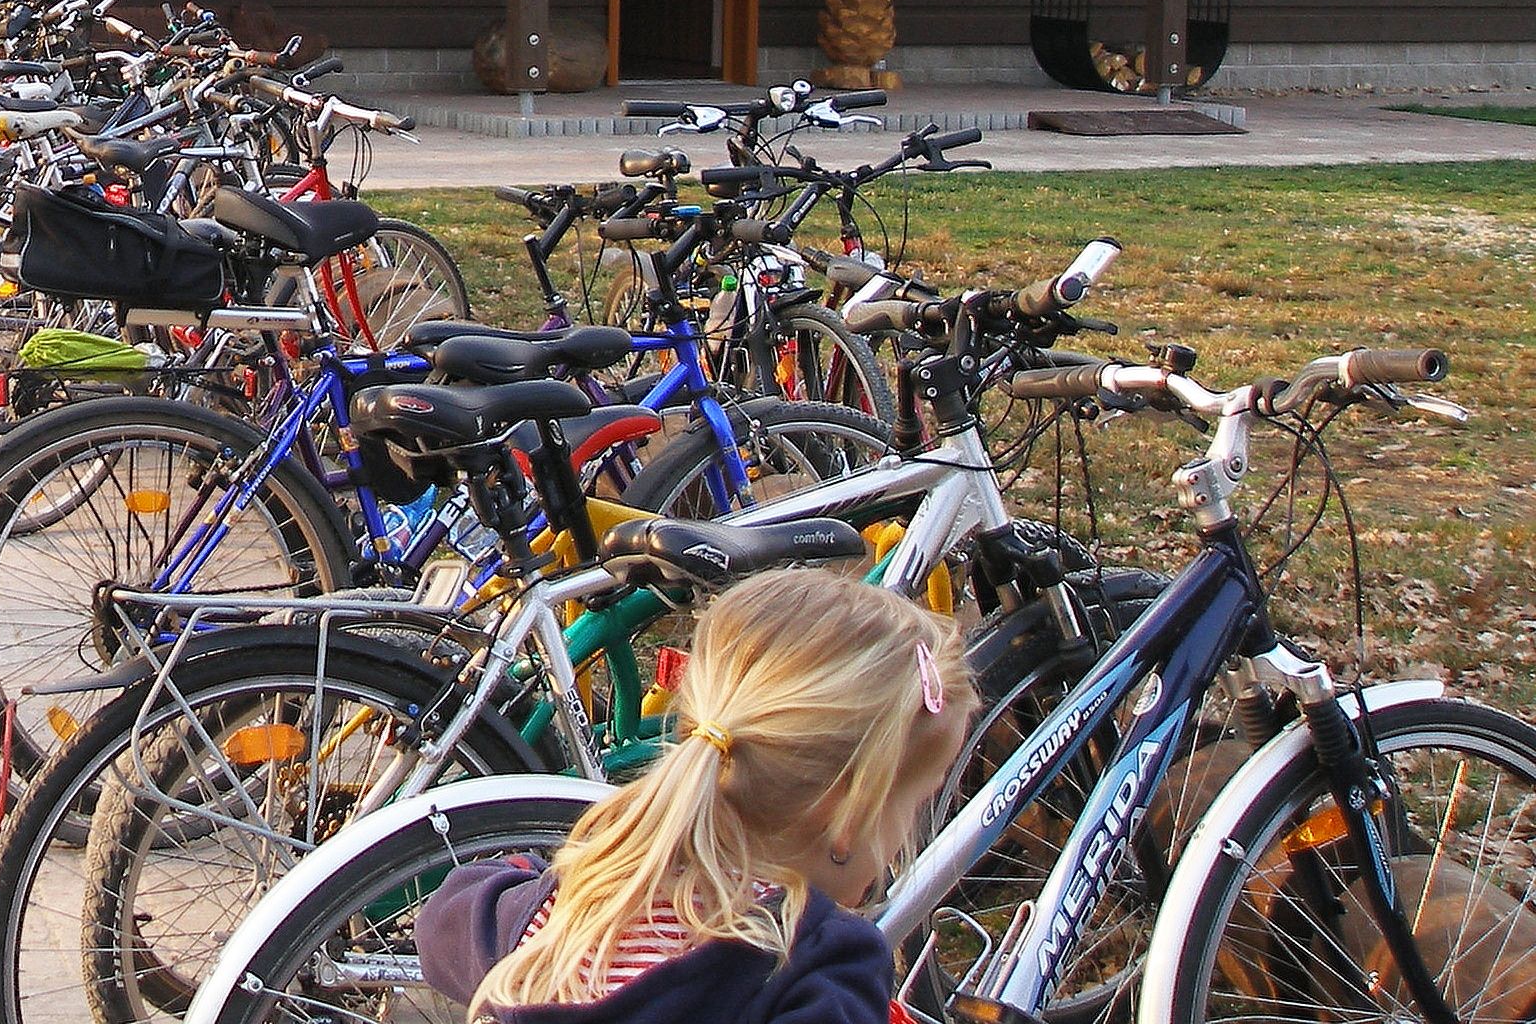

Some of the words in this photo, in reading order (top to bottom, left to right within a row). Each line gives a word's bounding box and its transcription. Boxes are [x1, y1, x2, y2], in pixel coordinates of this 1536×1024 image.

[792, 530, 837, 545] comfort
[979, 707, 1086, 829] CROSSWAY
[1036, 738, 1162, 979] MERIDA
